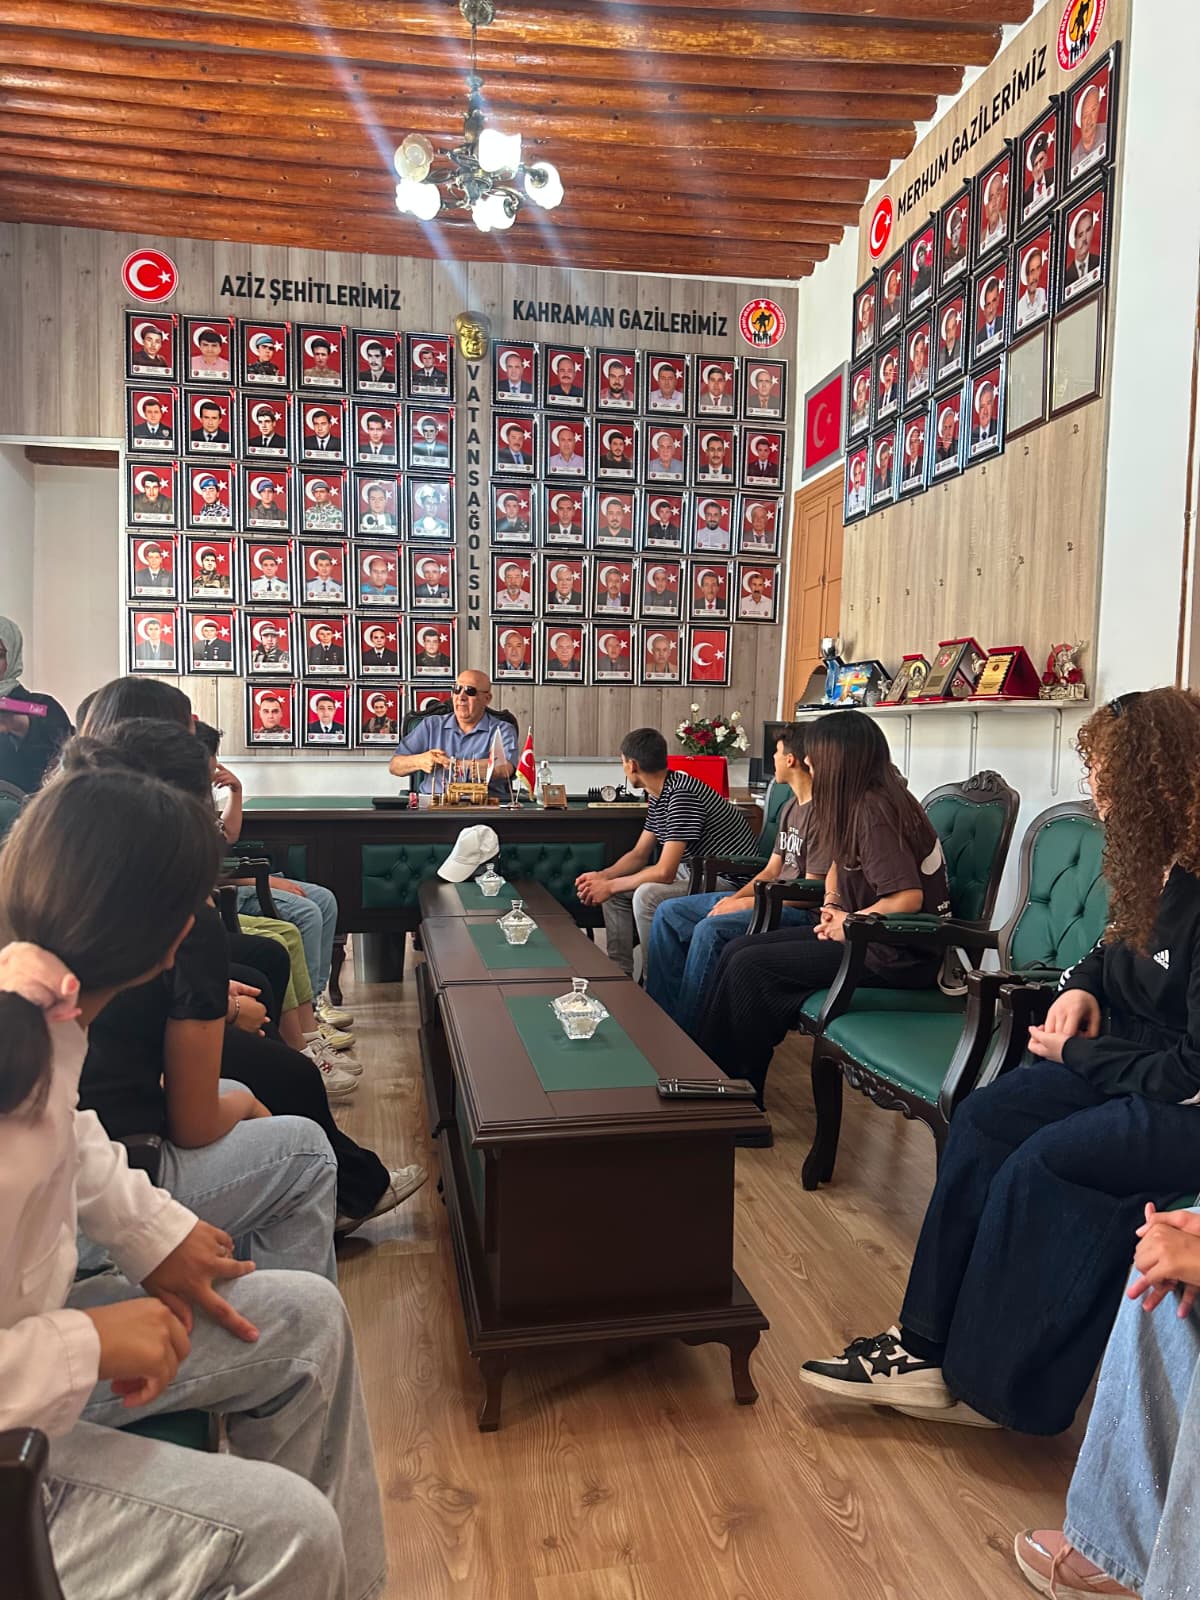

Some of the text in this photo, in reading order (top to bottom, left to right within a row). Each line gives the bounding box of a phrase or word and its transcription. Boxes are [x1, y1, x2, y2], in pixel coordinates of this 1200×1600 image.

[898, 45, 1047, 221] MERHUM GAZİLERİMİZ
[220, 272, 401, 310] AZİZ ŞEHİTLERİMİZ
[513, 300, 614, 328] KAHRAMAN
[619, 306, 728, 336] GAZİLERİMİZ
